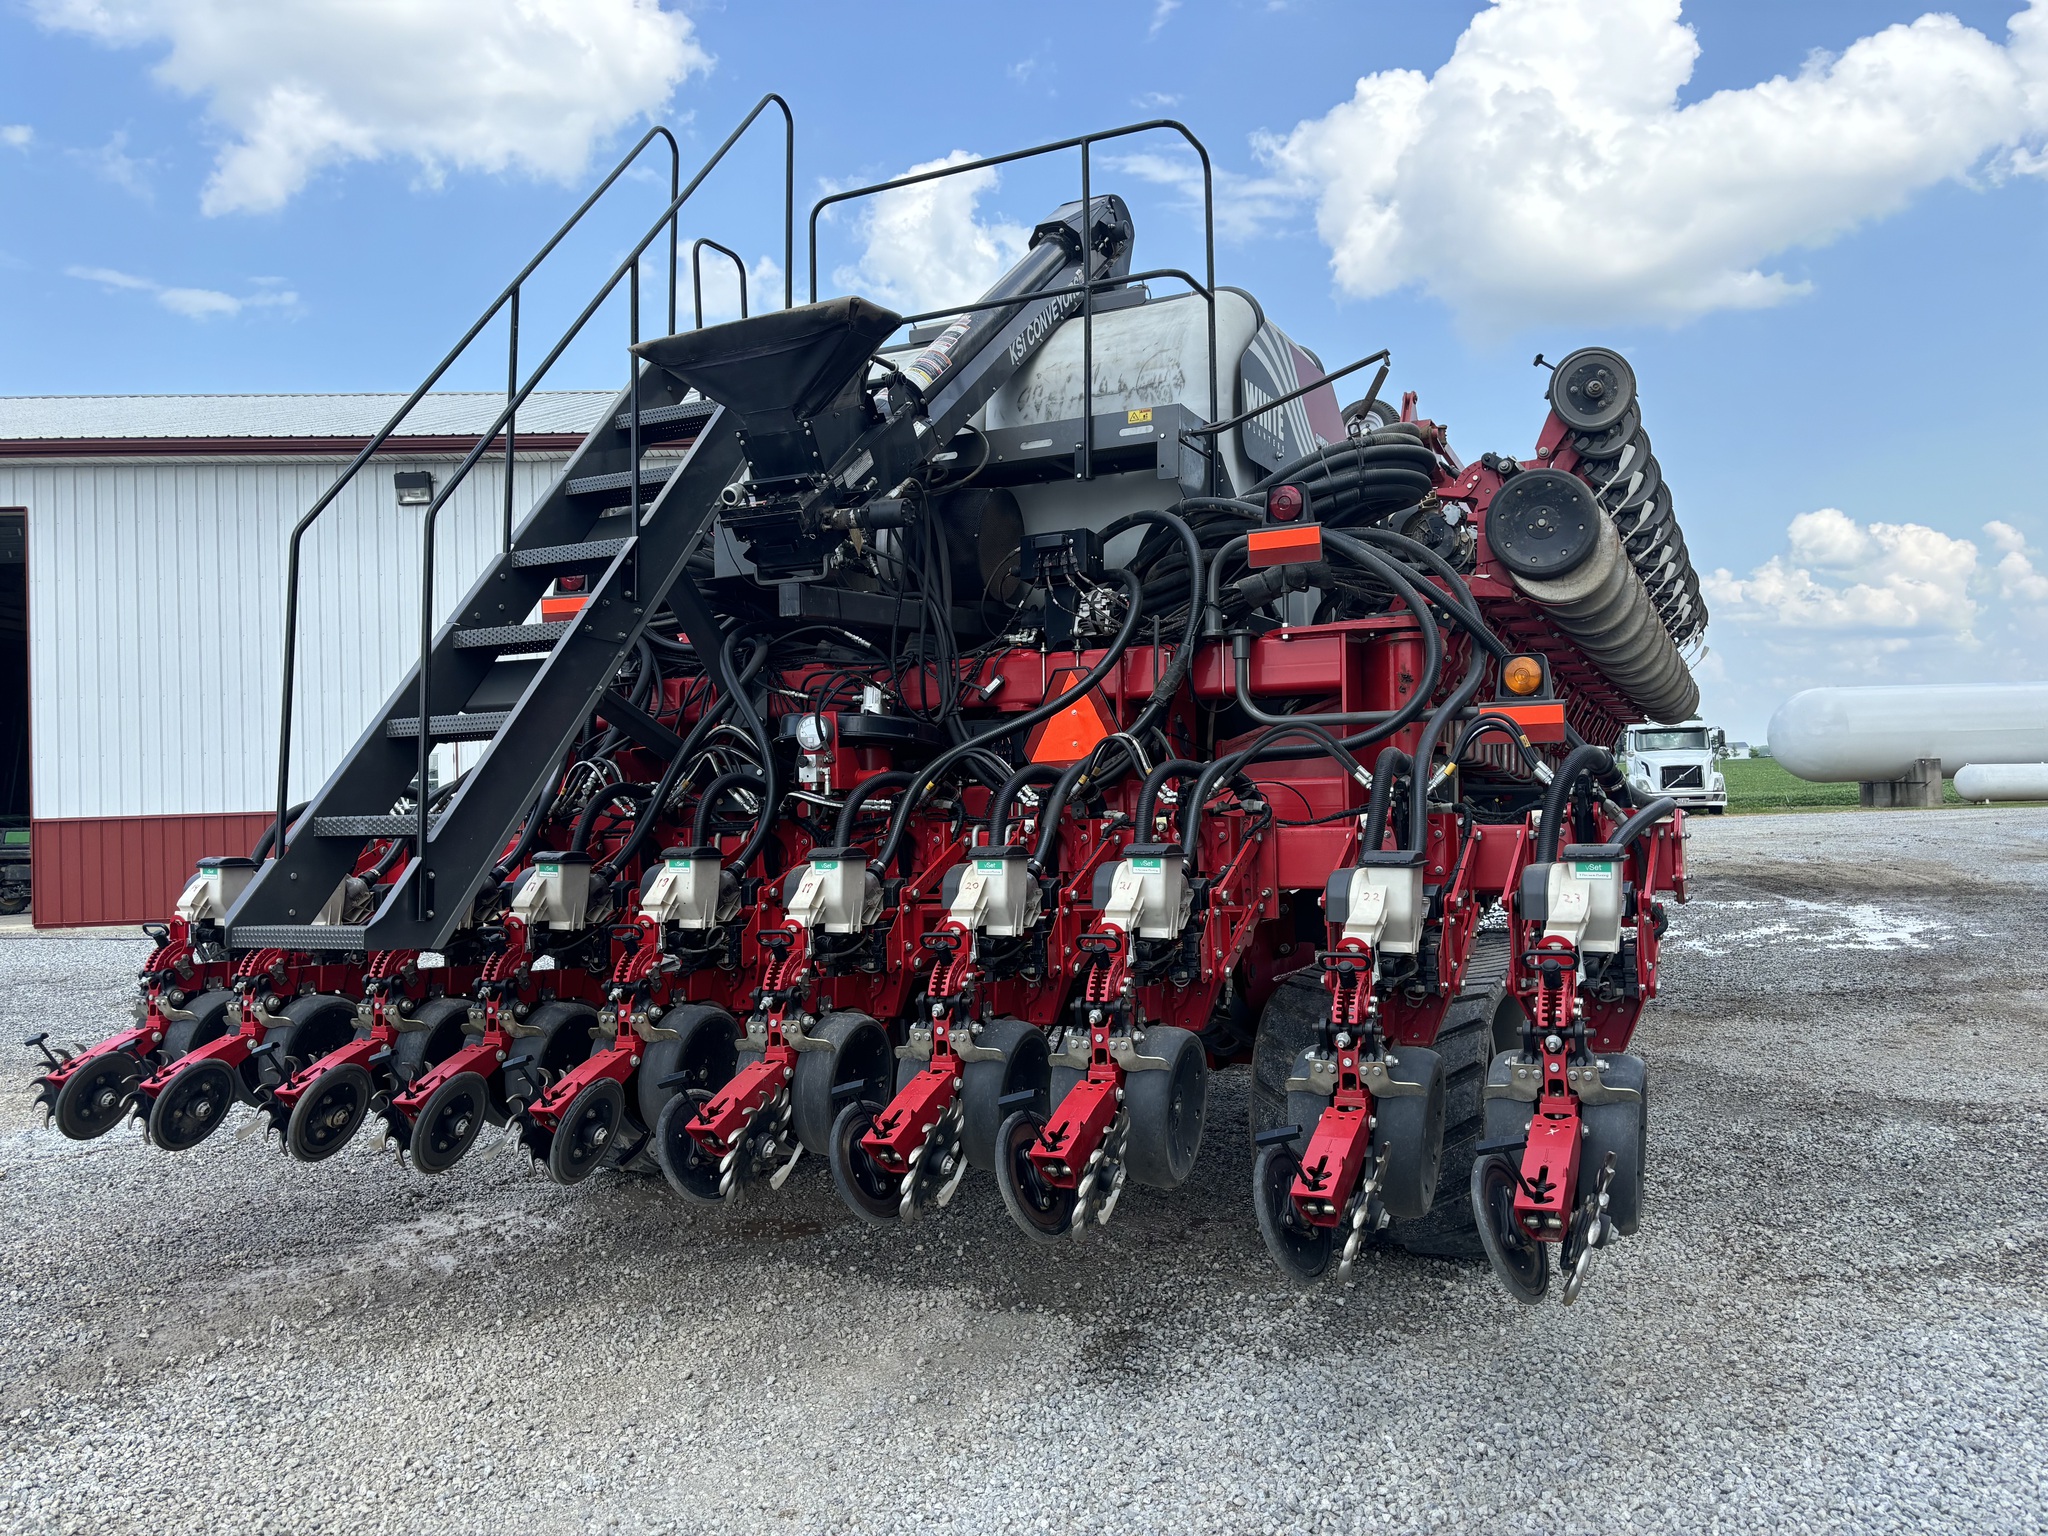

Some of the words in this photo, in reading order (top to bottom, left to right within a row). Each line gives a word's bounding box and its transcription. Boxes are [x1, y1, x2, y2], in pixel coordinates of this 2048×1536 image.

[1244, 378, 1284, 441] WHITE
[1247, 421, 1285, 453] PLANTERS
[1585, 863, 1602, 871] vSet
[1120, 881, 1131, 890] 21
[1363, 892, 1379, 901] 22
[1562, 893, 1580, 903] 23
